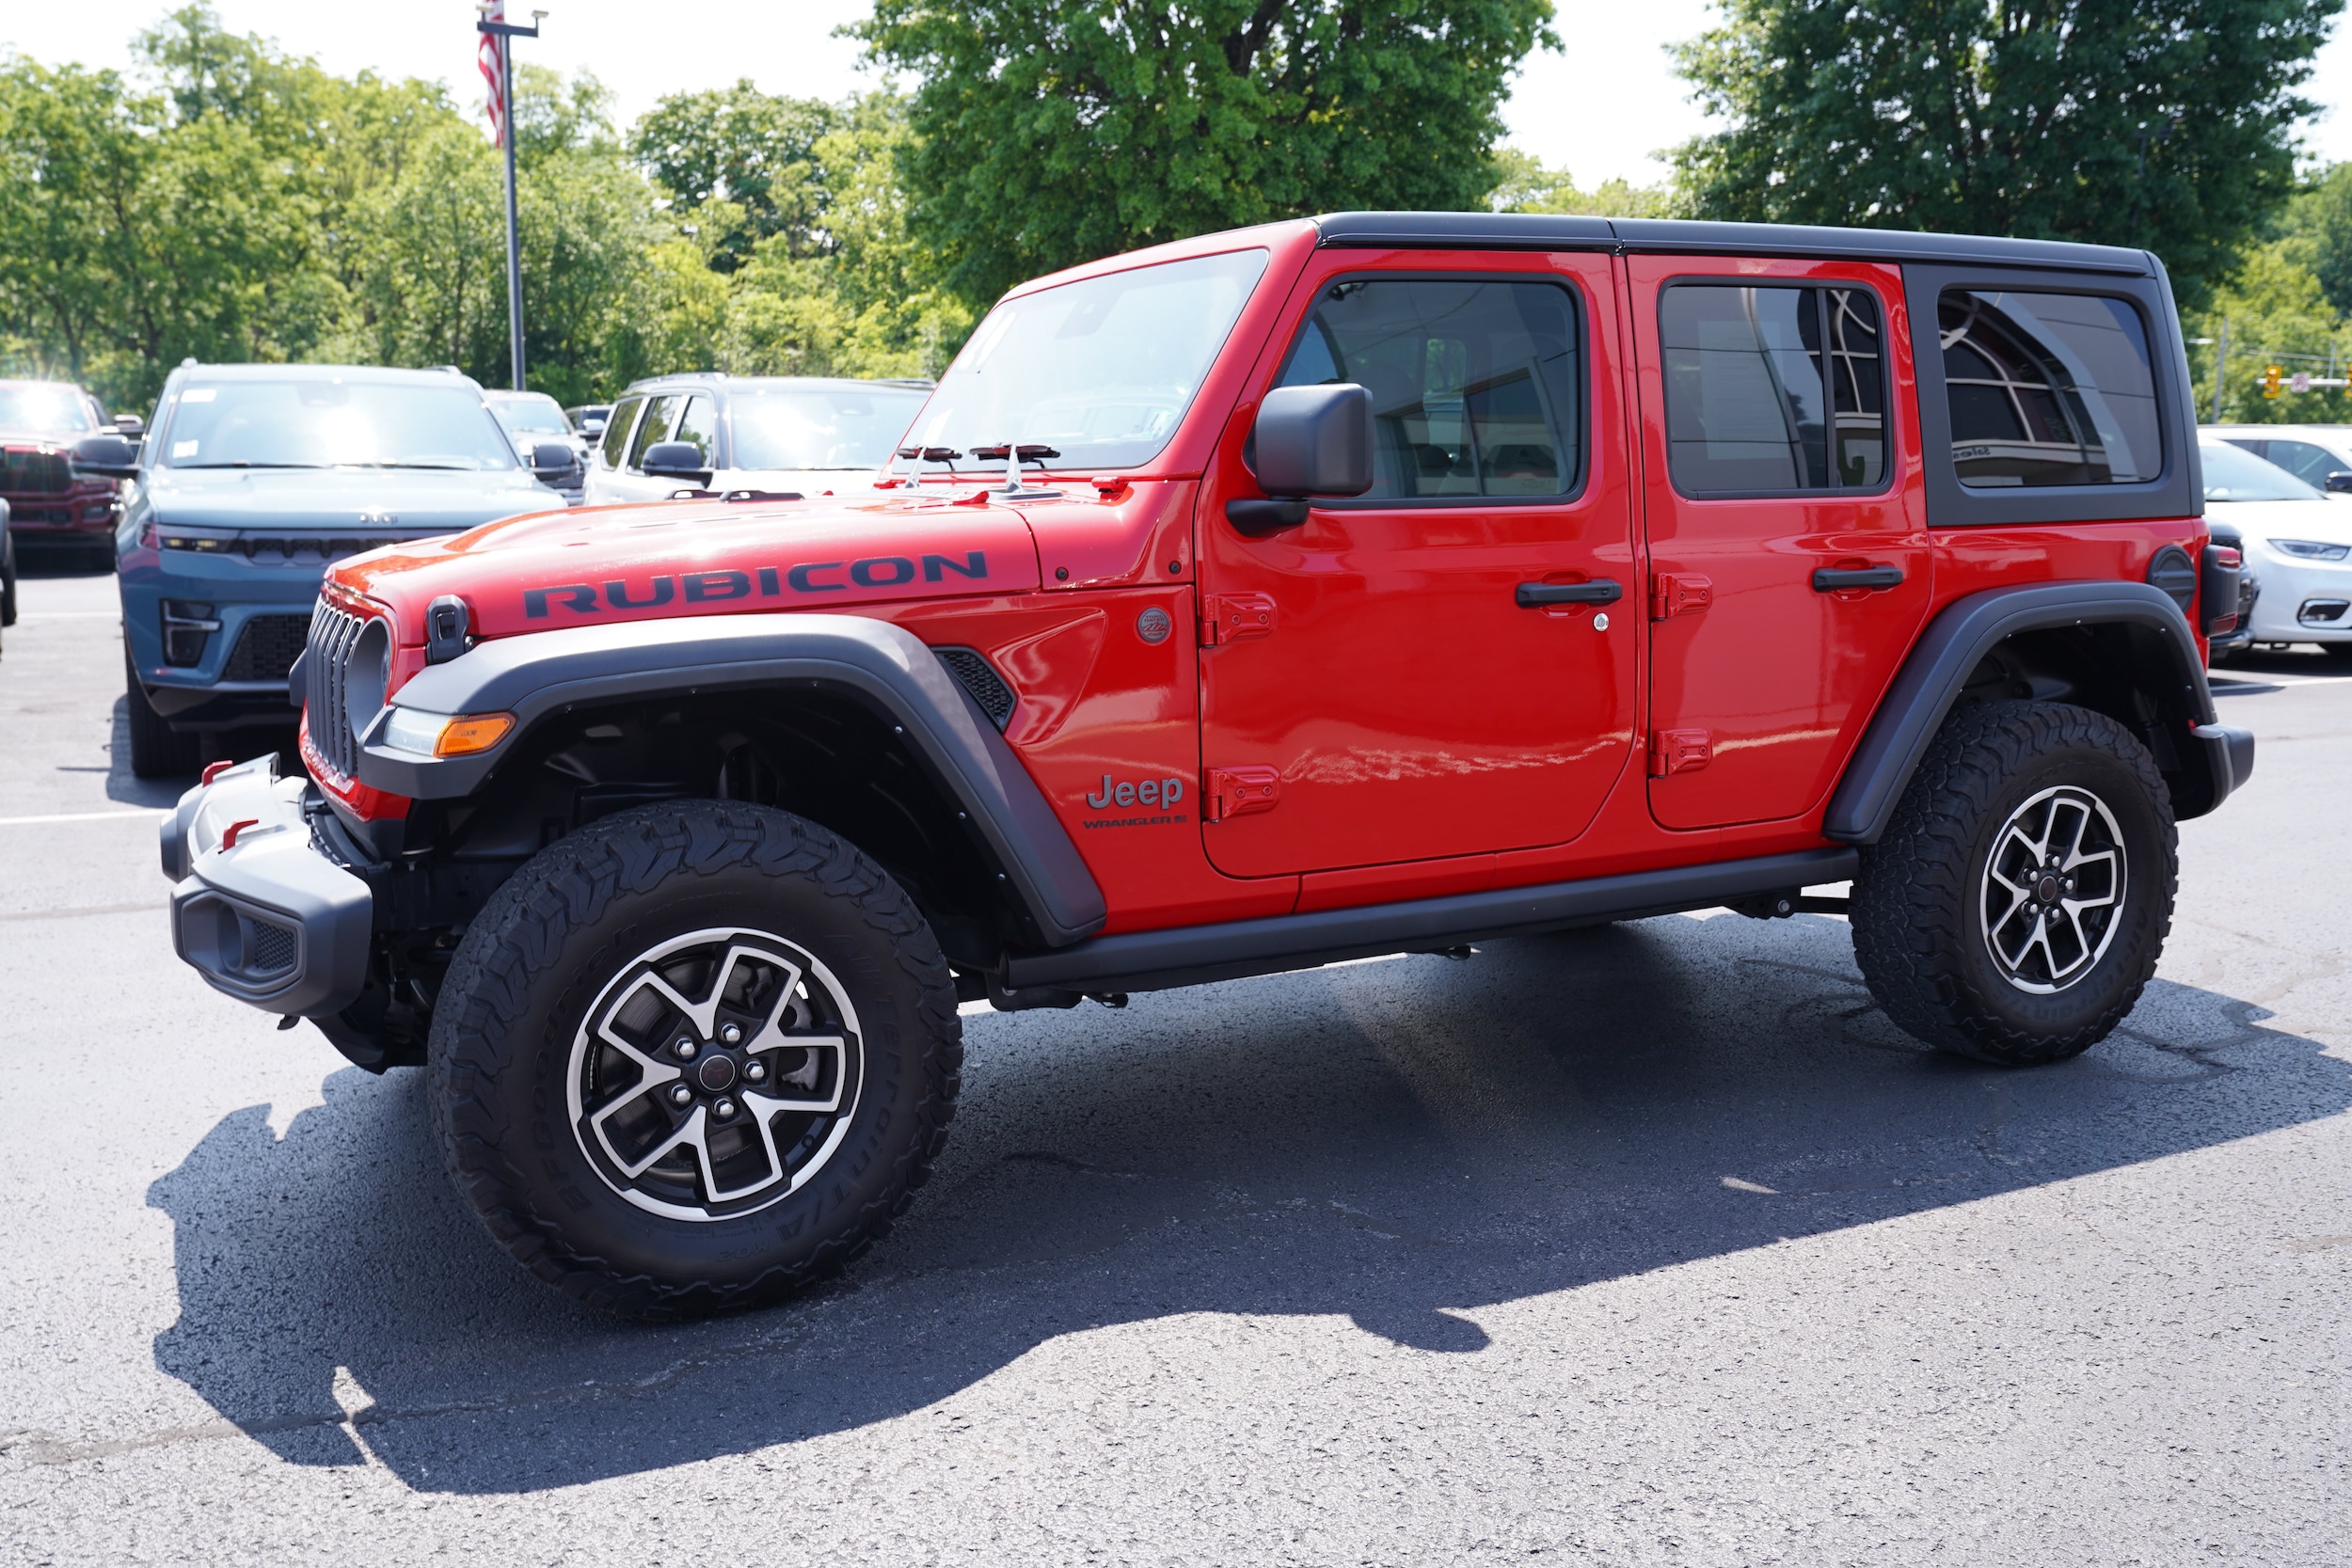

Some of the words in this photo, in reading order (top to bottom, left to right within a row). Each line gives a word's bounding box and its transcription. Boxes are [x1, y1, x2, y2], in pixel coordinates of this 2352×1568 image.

[522, 550, 989, 619] RUBICON
[1087, 774, 1184, 810] Jeep
[1083, 816, 1171, 830] WRANGLER
[531, 923, 637, 1213] BFGoodrich
